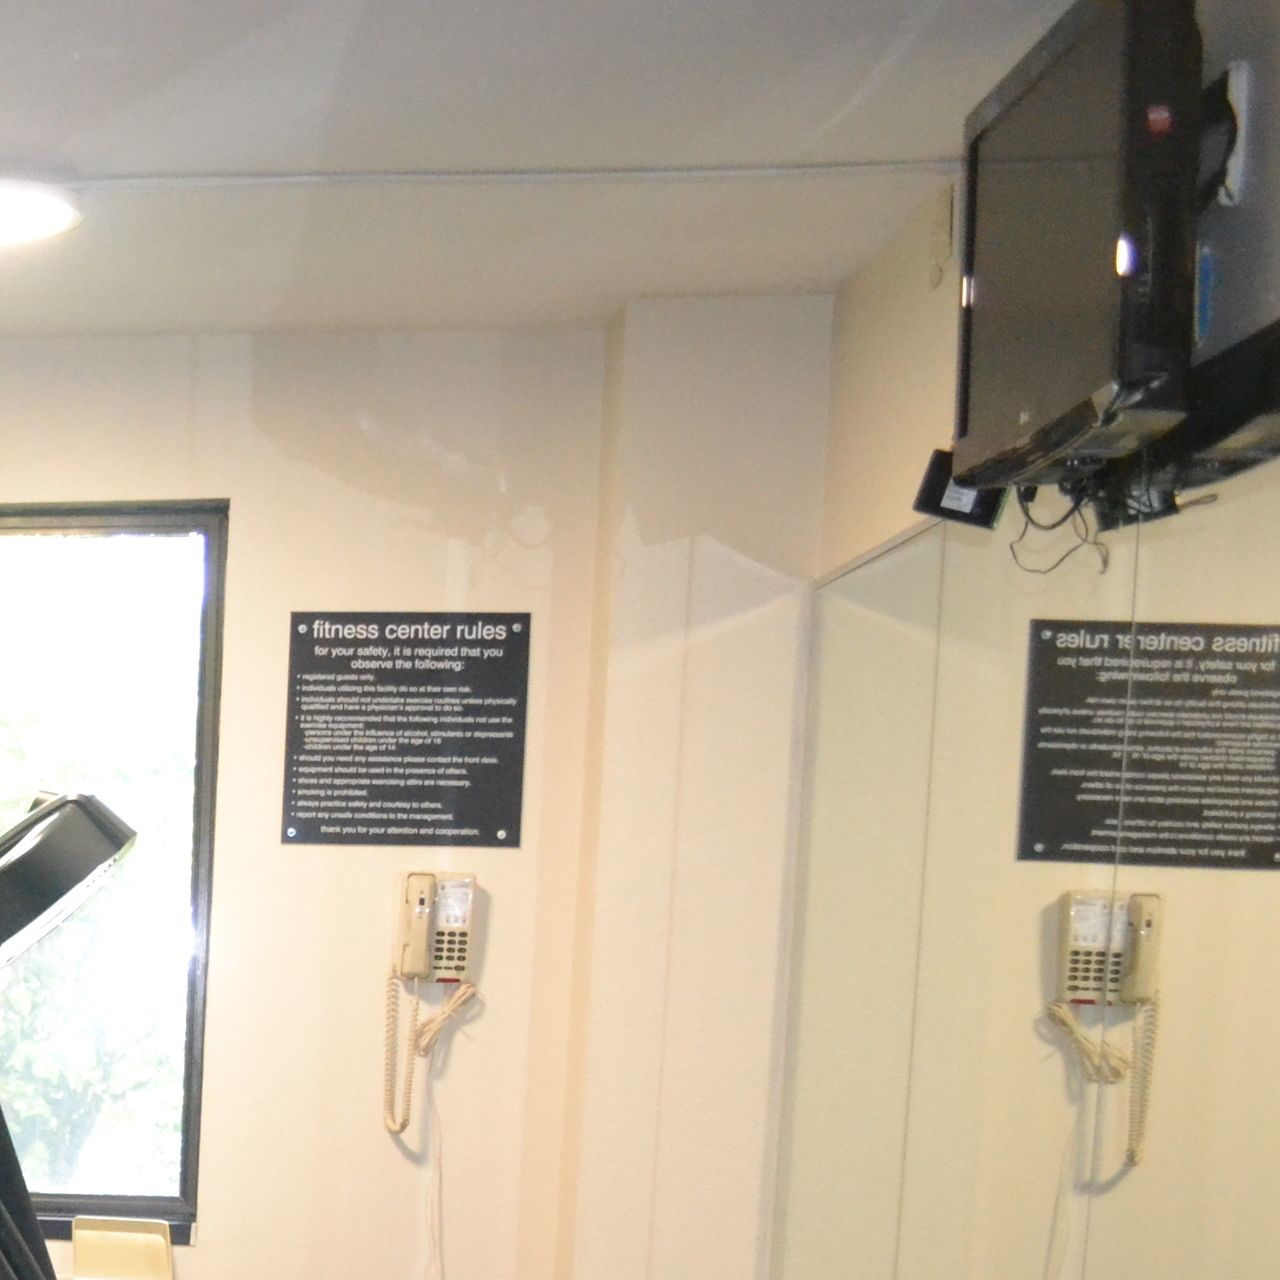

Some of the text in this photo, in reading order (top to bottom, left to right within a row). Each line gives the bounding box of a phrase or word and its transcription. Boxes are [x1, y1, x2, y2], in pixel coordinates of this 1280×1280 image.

[313, 621, 506, 640] fitness center rules
[315, 645, 503, 660] for your safety, it is required that you
[351, 660, 464, 671] observe the following:
